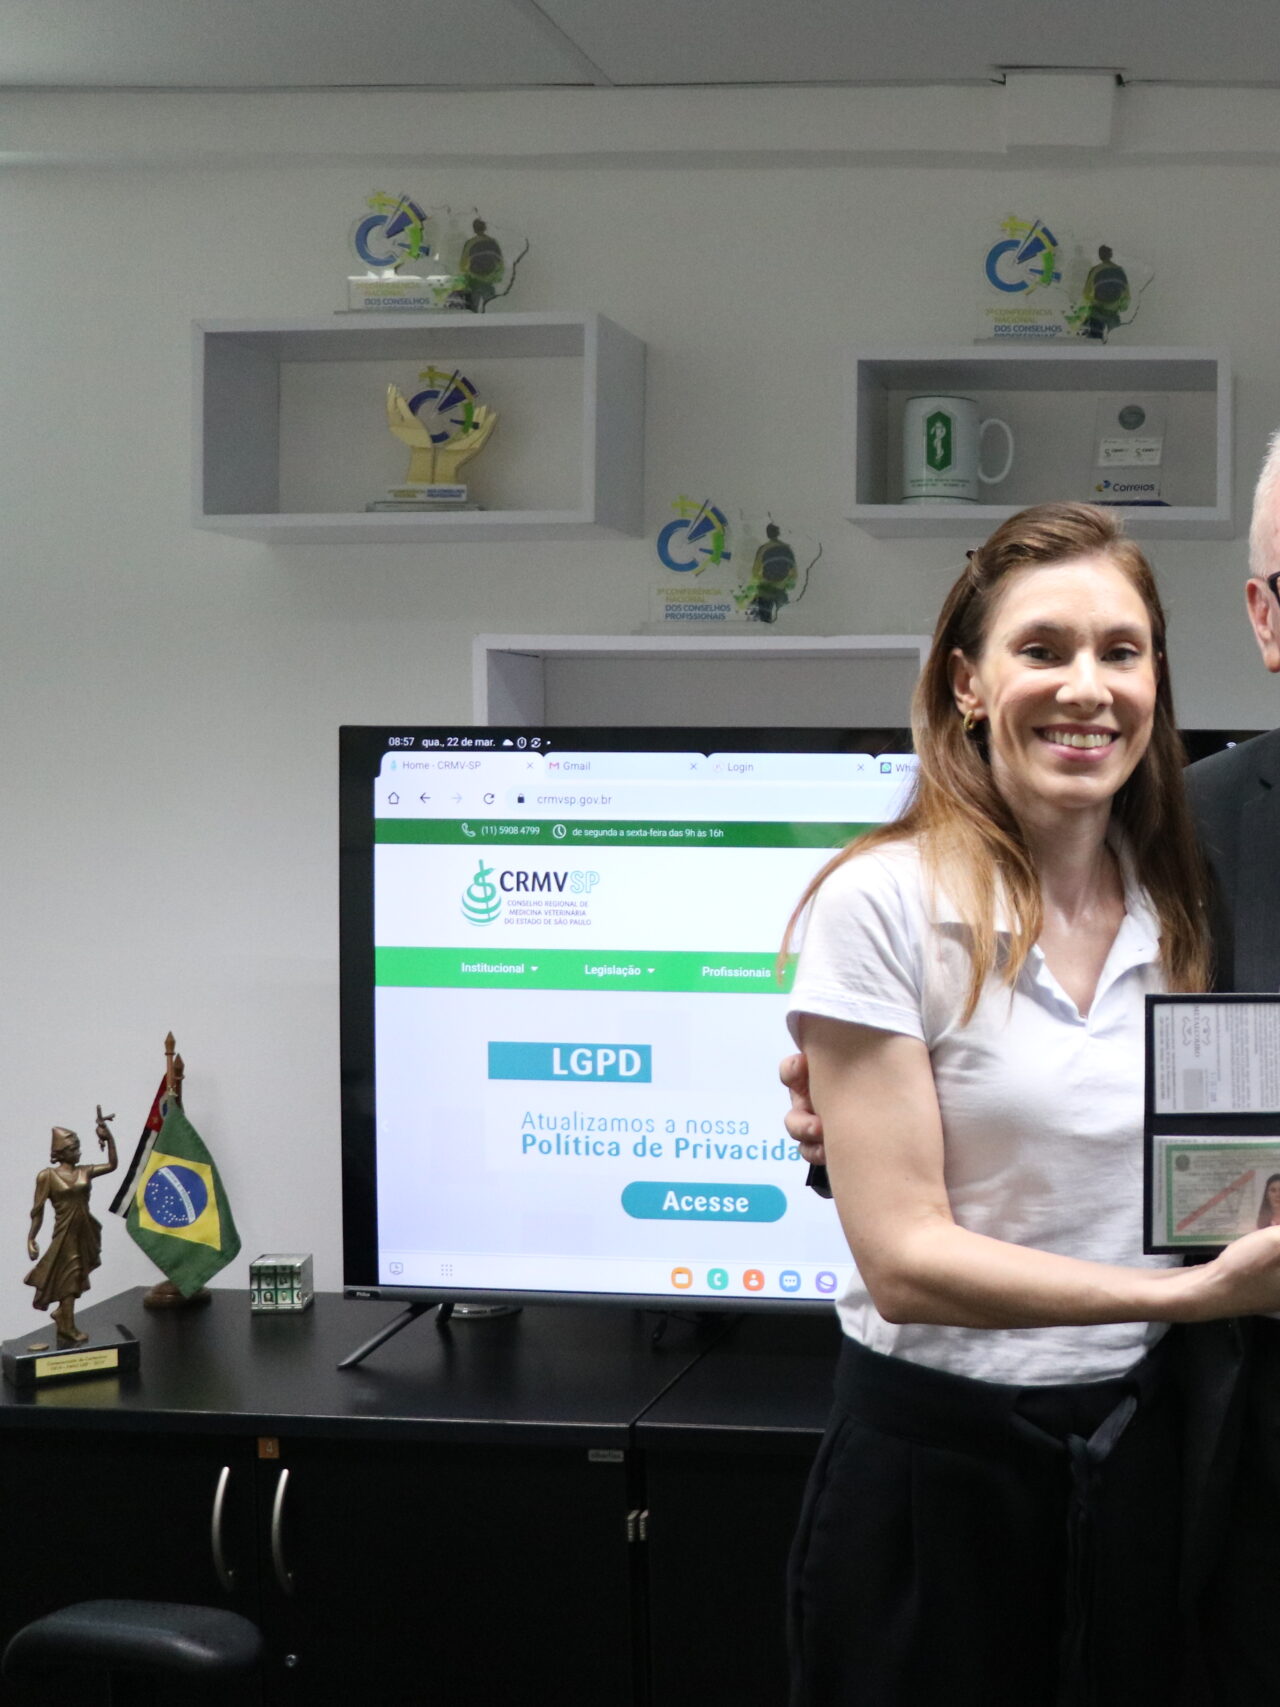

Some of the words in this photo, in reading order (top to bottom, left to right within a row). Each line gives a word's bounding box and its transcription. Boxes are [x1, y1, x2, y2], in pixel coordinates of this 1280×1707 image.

[383, 297, 430, 305] CONSELHOS
[1112, 483, 1155, 492] Correios
[683, 604, 731, 612] CONSELHOS
[388, 737, 415, 746] 08:57
[422, 738, 445, 748] qua.,
[447, 737, 459, 746] 22
[461, 737, 473, 747] de
[474, 738, 496, 747] mar.
[402, 760, 430, 770] Home
[437, 760, 482, 770] CRMV-SP
[563, 761, 591, 771] Gmail
[727, 762, 754, 773] Login
[536, 795, 612, 807] crmvsp.gov.br
[481, 825, 497, 837] (11)
[499, 825, 519, 835] 5908
[520, 826, 540, 836] 4799
[572, 828, 582, 836] de
[584, 828, 618, 838] segunda
[626, 828, 667, 837] sexta-feira
[668, 828, 684, 837] das
[685, 828, 696, 838] 9h
[709, 828, 724, 838] 16h
[544, 900, 578, 908] REGIONAL
[544, 908, 586, 917] VETERINÁRIA
[554, 917, 568, 925] SÃO
[570, 918, 592, 926] PAULO
[461, 962, 525, 974] Institucional
[584, 964, 641, 977] Legislação
[702, 965, 771, 978] Profissionais
[552, 1047, 642, 1077] LGPD
[521, 1110, 655, 1133] Atualizamos
[665, 1119, 676, 1134] a
[686, 1119, 750, 1136] nossa
[521, 1133, 621, 1157] Política
[633, 1135, 663, 1158] de
[675, 1137, 802, 1161] Privacida
[662, 1190, 750, 1213] Acesse
